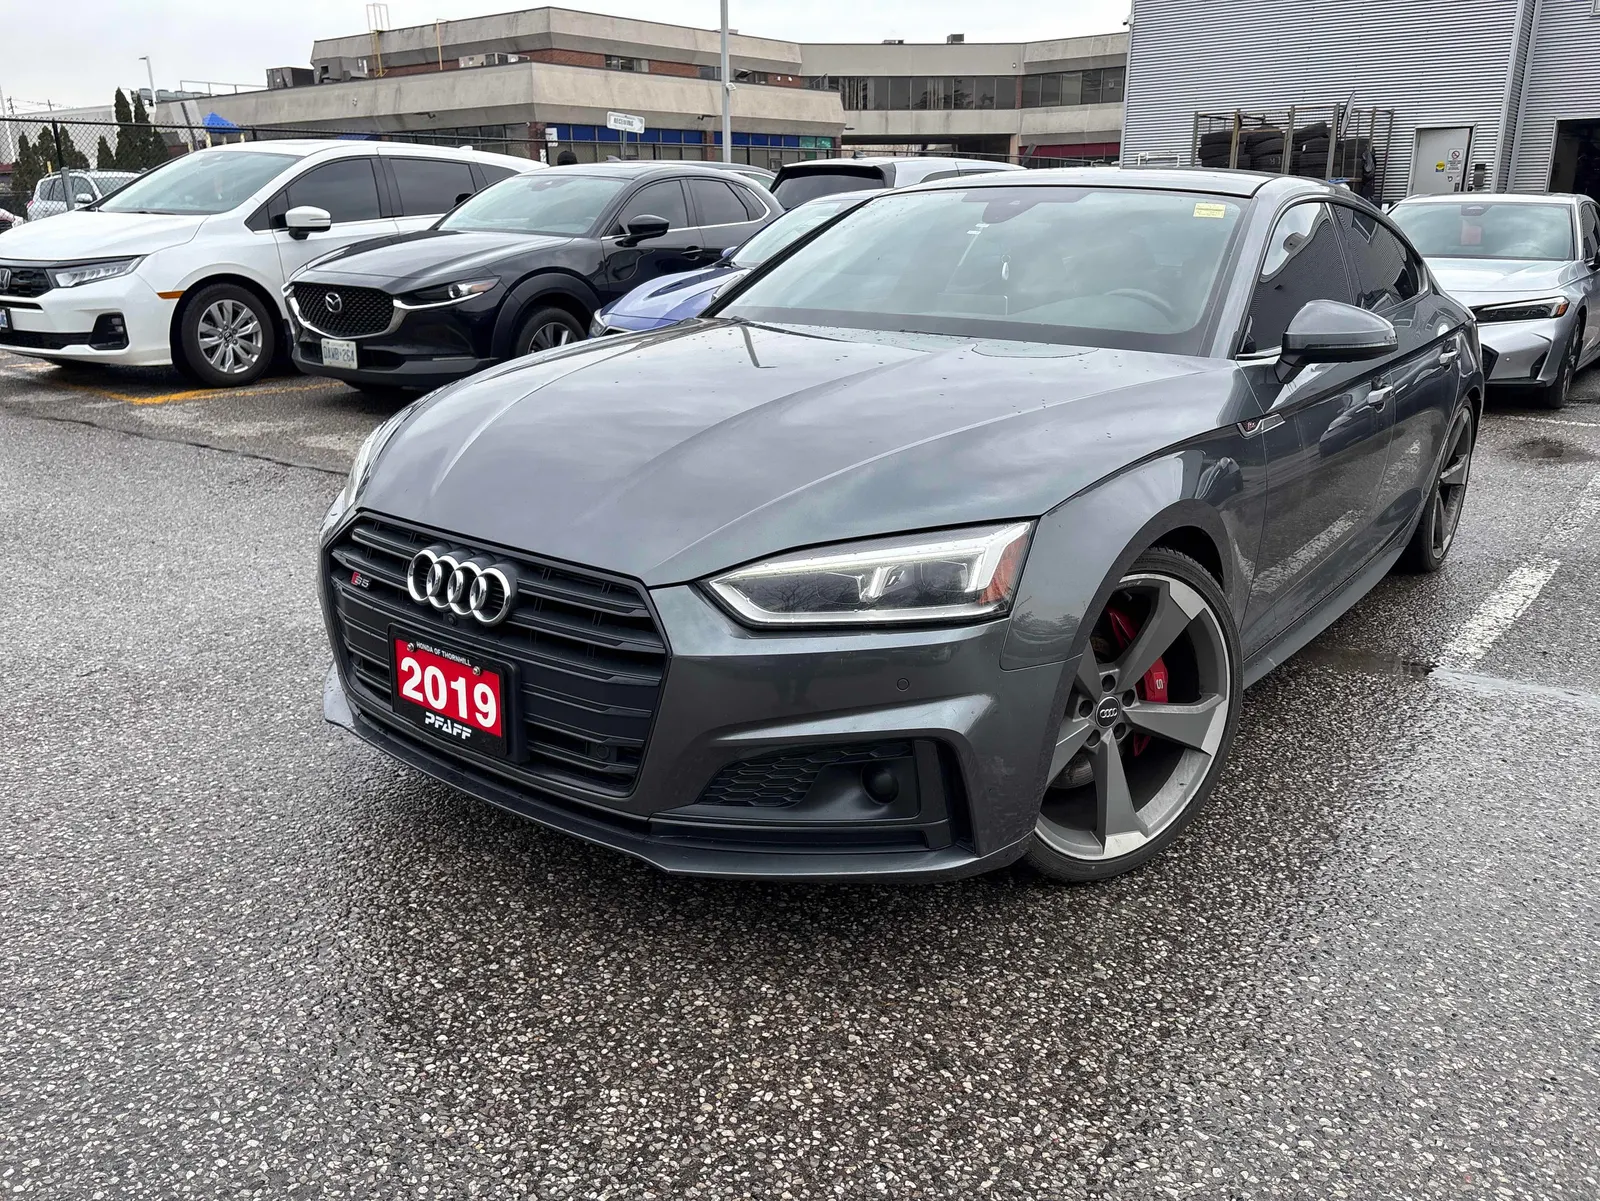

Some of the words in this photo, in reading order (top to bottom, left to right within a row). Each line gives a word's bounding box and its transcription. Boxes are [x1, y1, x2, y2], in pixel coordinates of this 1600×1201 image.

[613, 117, 634, 127] RECEIVING
[416, 641, 433, 653] HONDA
[433, 647, 441, 656] OF
[441, 650, 472, 667] THORNHILL
[400, 656, 497, 728] 2019
[425, 711, 472, 740] PFAFF
